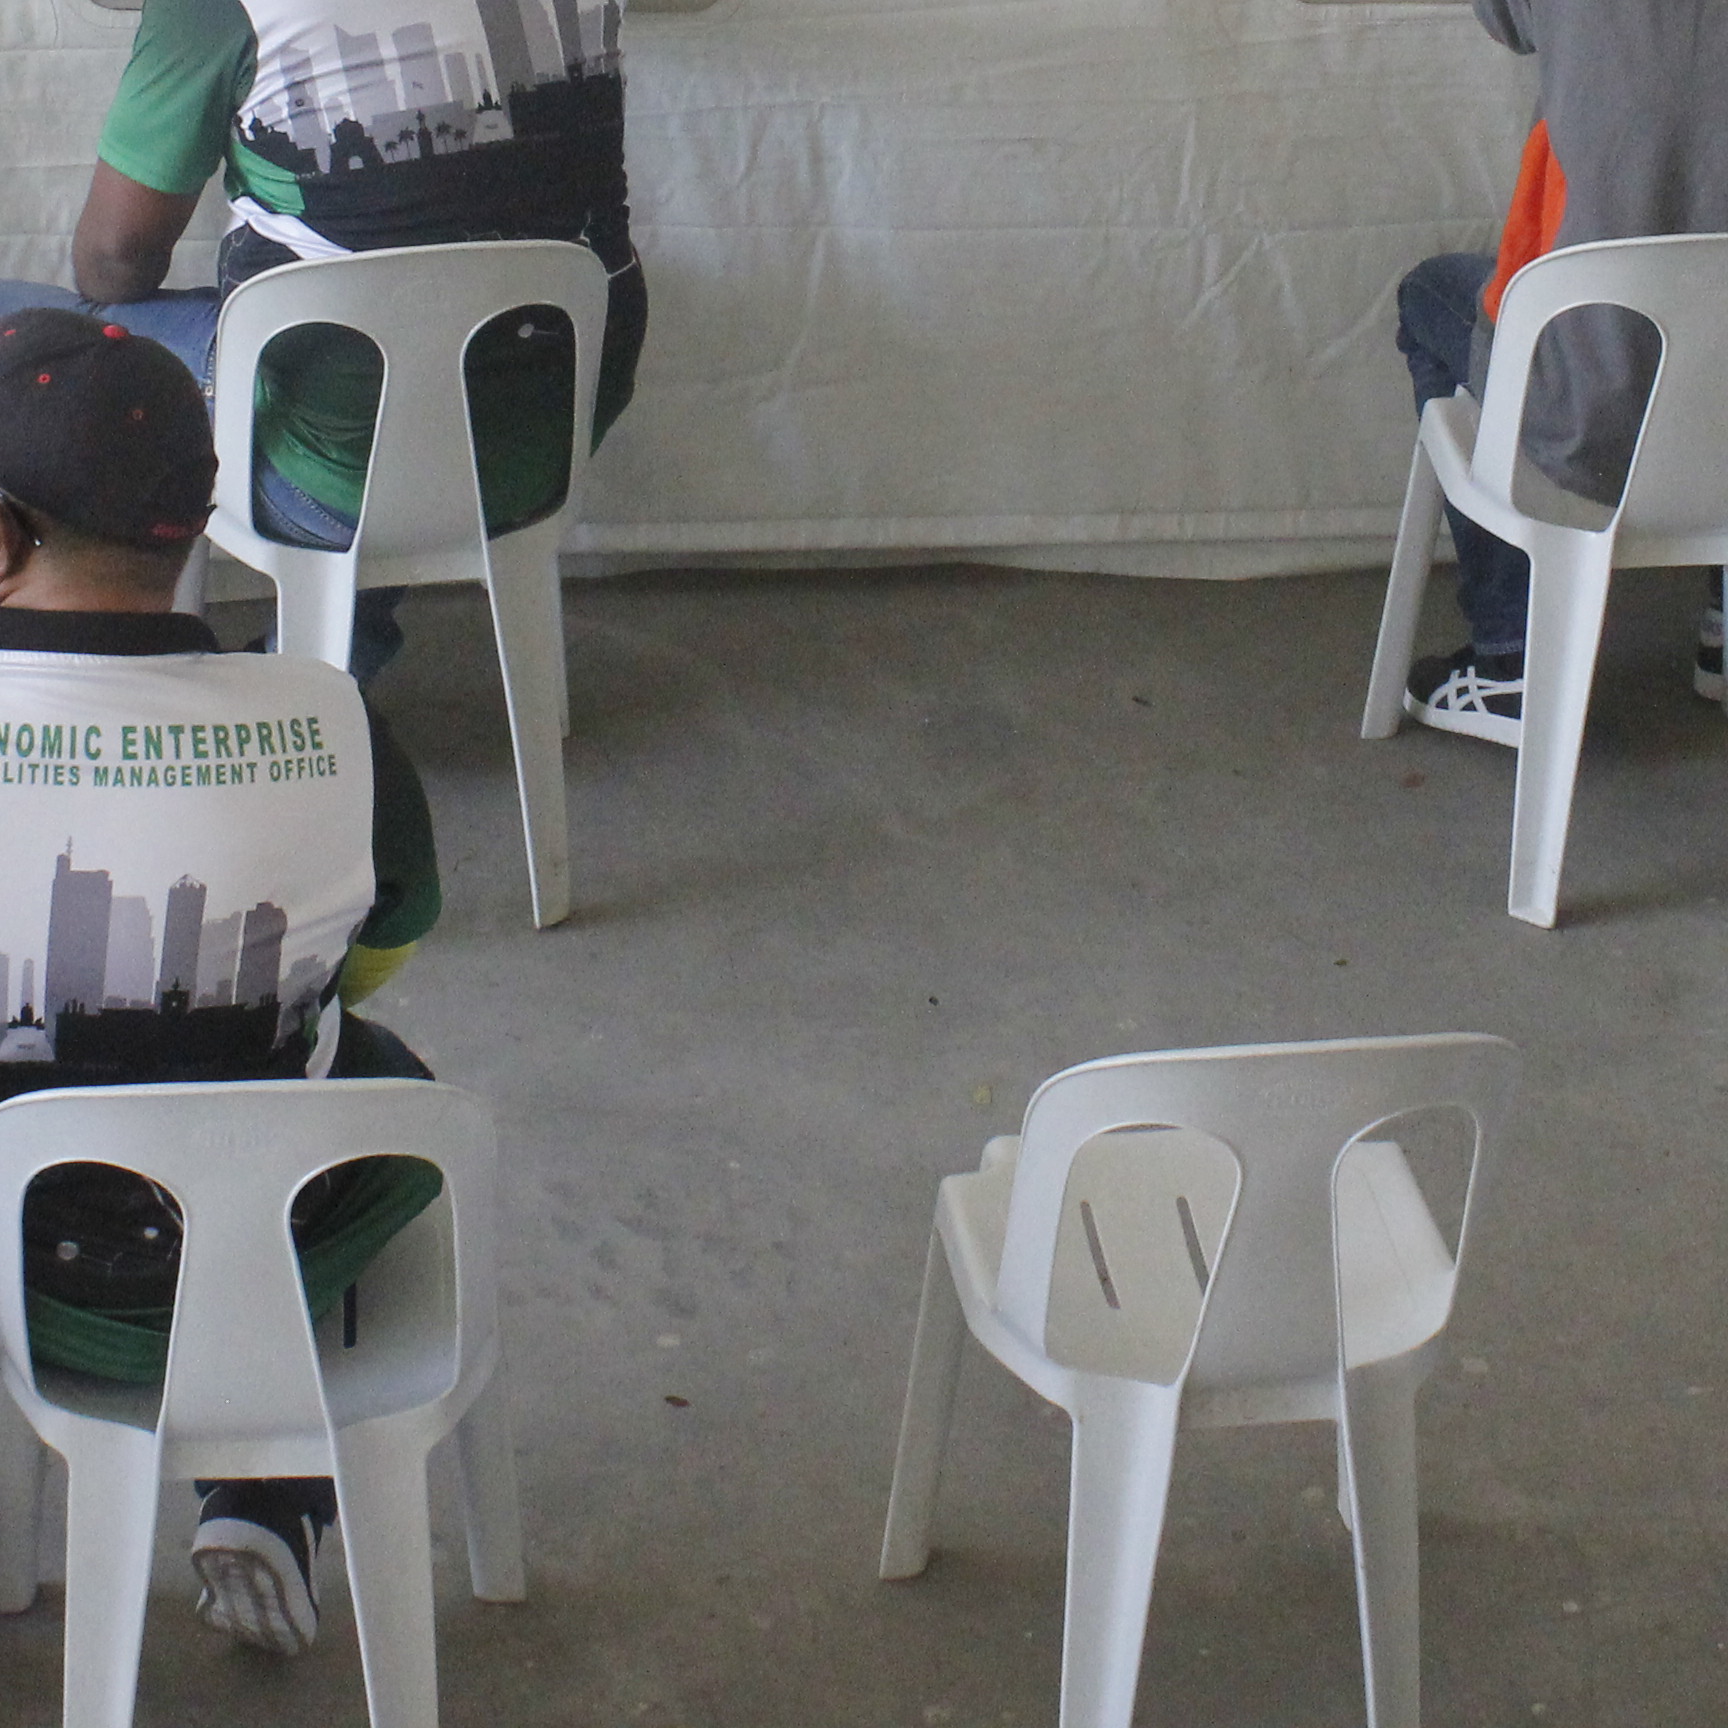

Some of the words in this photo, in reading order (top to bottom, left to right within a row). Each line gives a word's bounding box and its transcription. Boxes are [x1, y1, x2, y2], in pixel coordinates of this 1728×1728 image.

[122, 717, 324, 760] ENTERPRISE
[93, 762, 258, 788] MANAGEMENT
[269, 754, 338, 783] OFFICE
